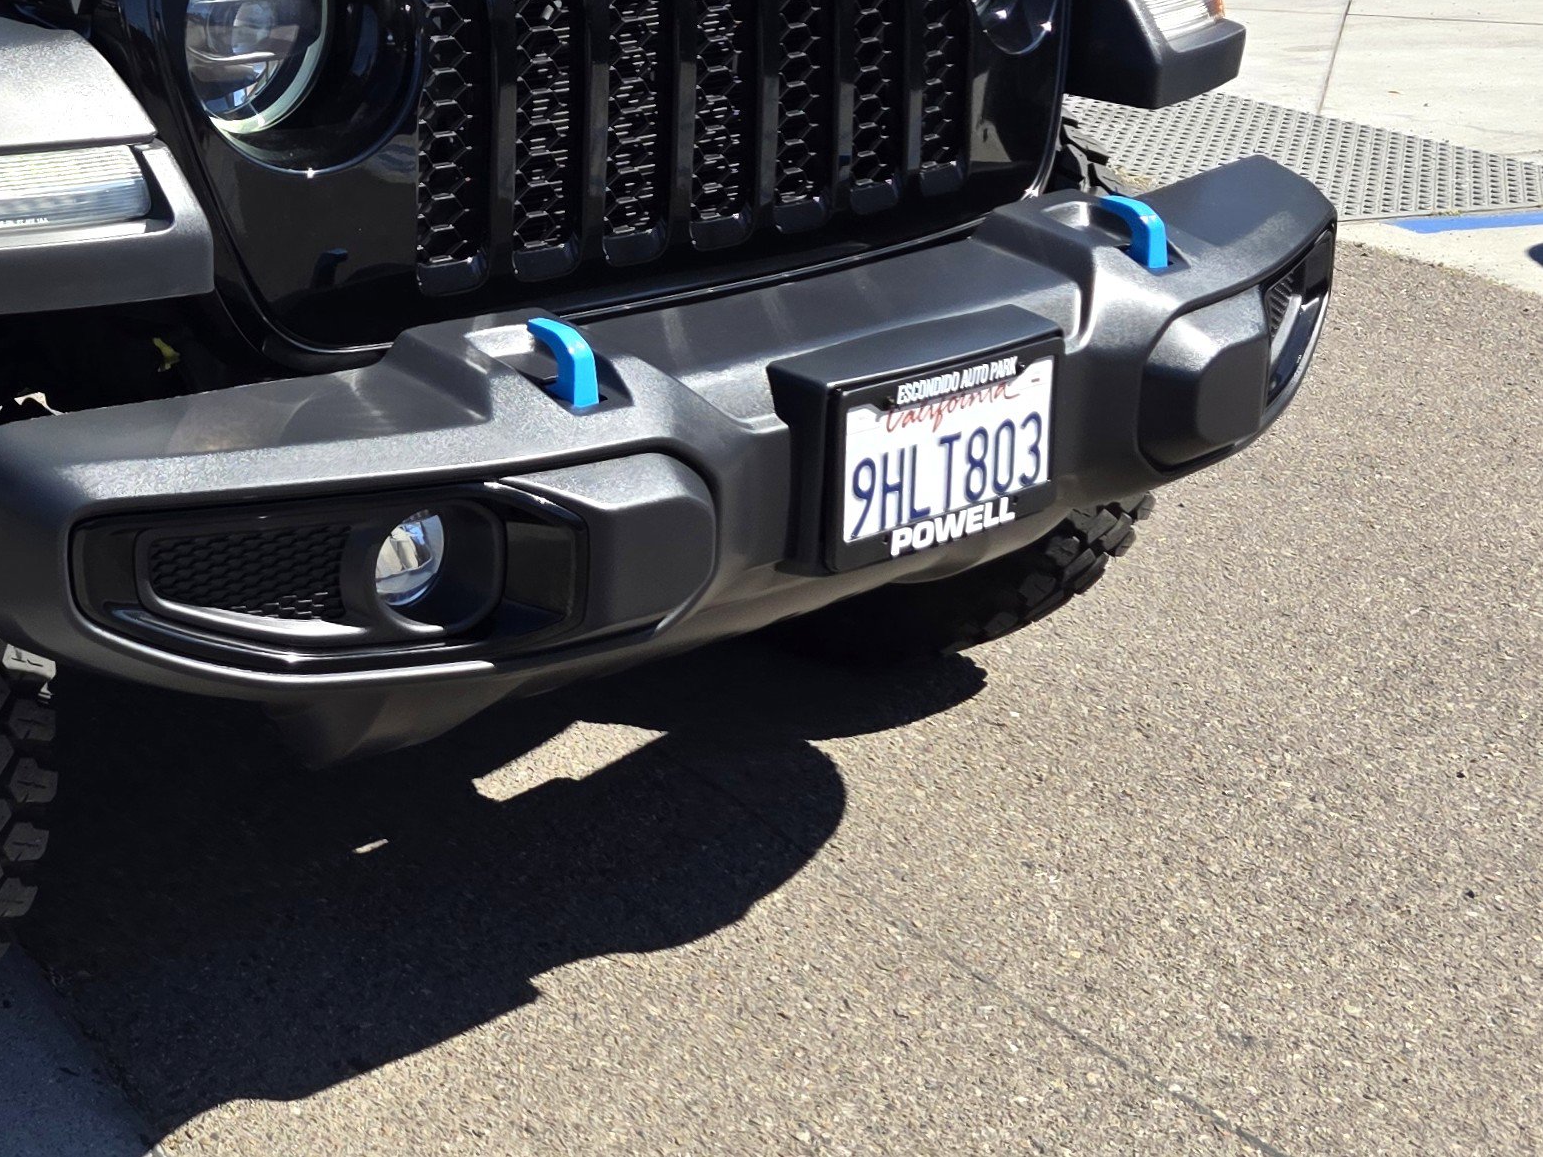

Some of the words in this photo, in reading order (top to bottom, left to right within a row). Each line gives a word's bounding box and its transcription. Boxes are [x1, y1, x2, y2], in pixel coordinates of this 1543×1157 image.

[886, 381, 1020, 433] California
[897, 371, 960, 405] ESCONDIDO
[960, 363, 990, 389] AUTO
[989, 355, 1018, 381] PARK
[851, 411, 1043, 539] 9HLT803
[890, 496, 1016, 557] POWELL
